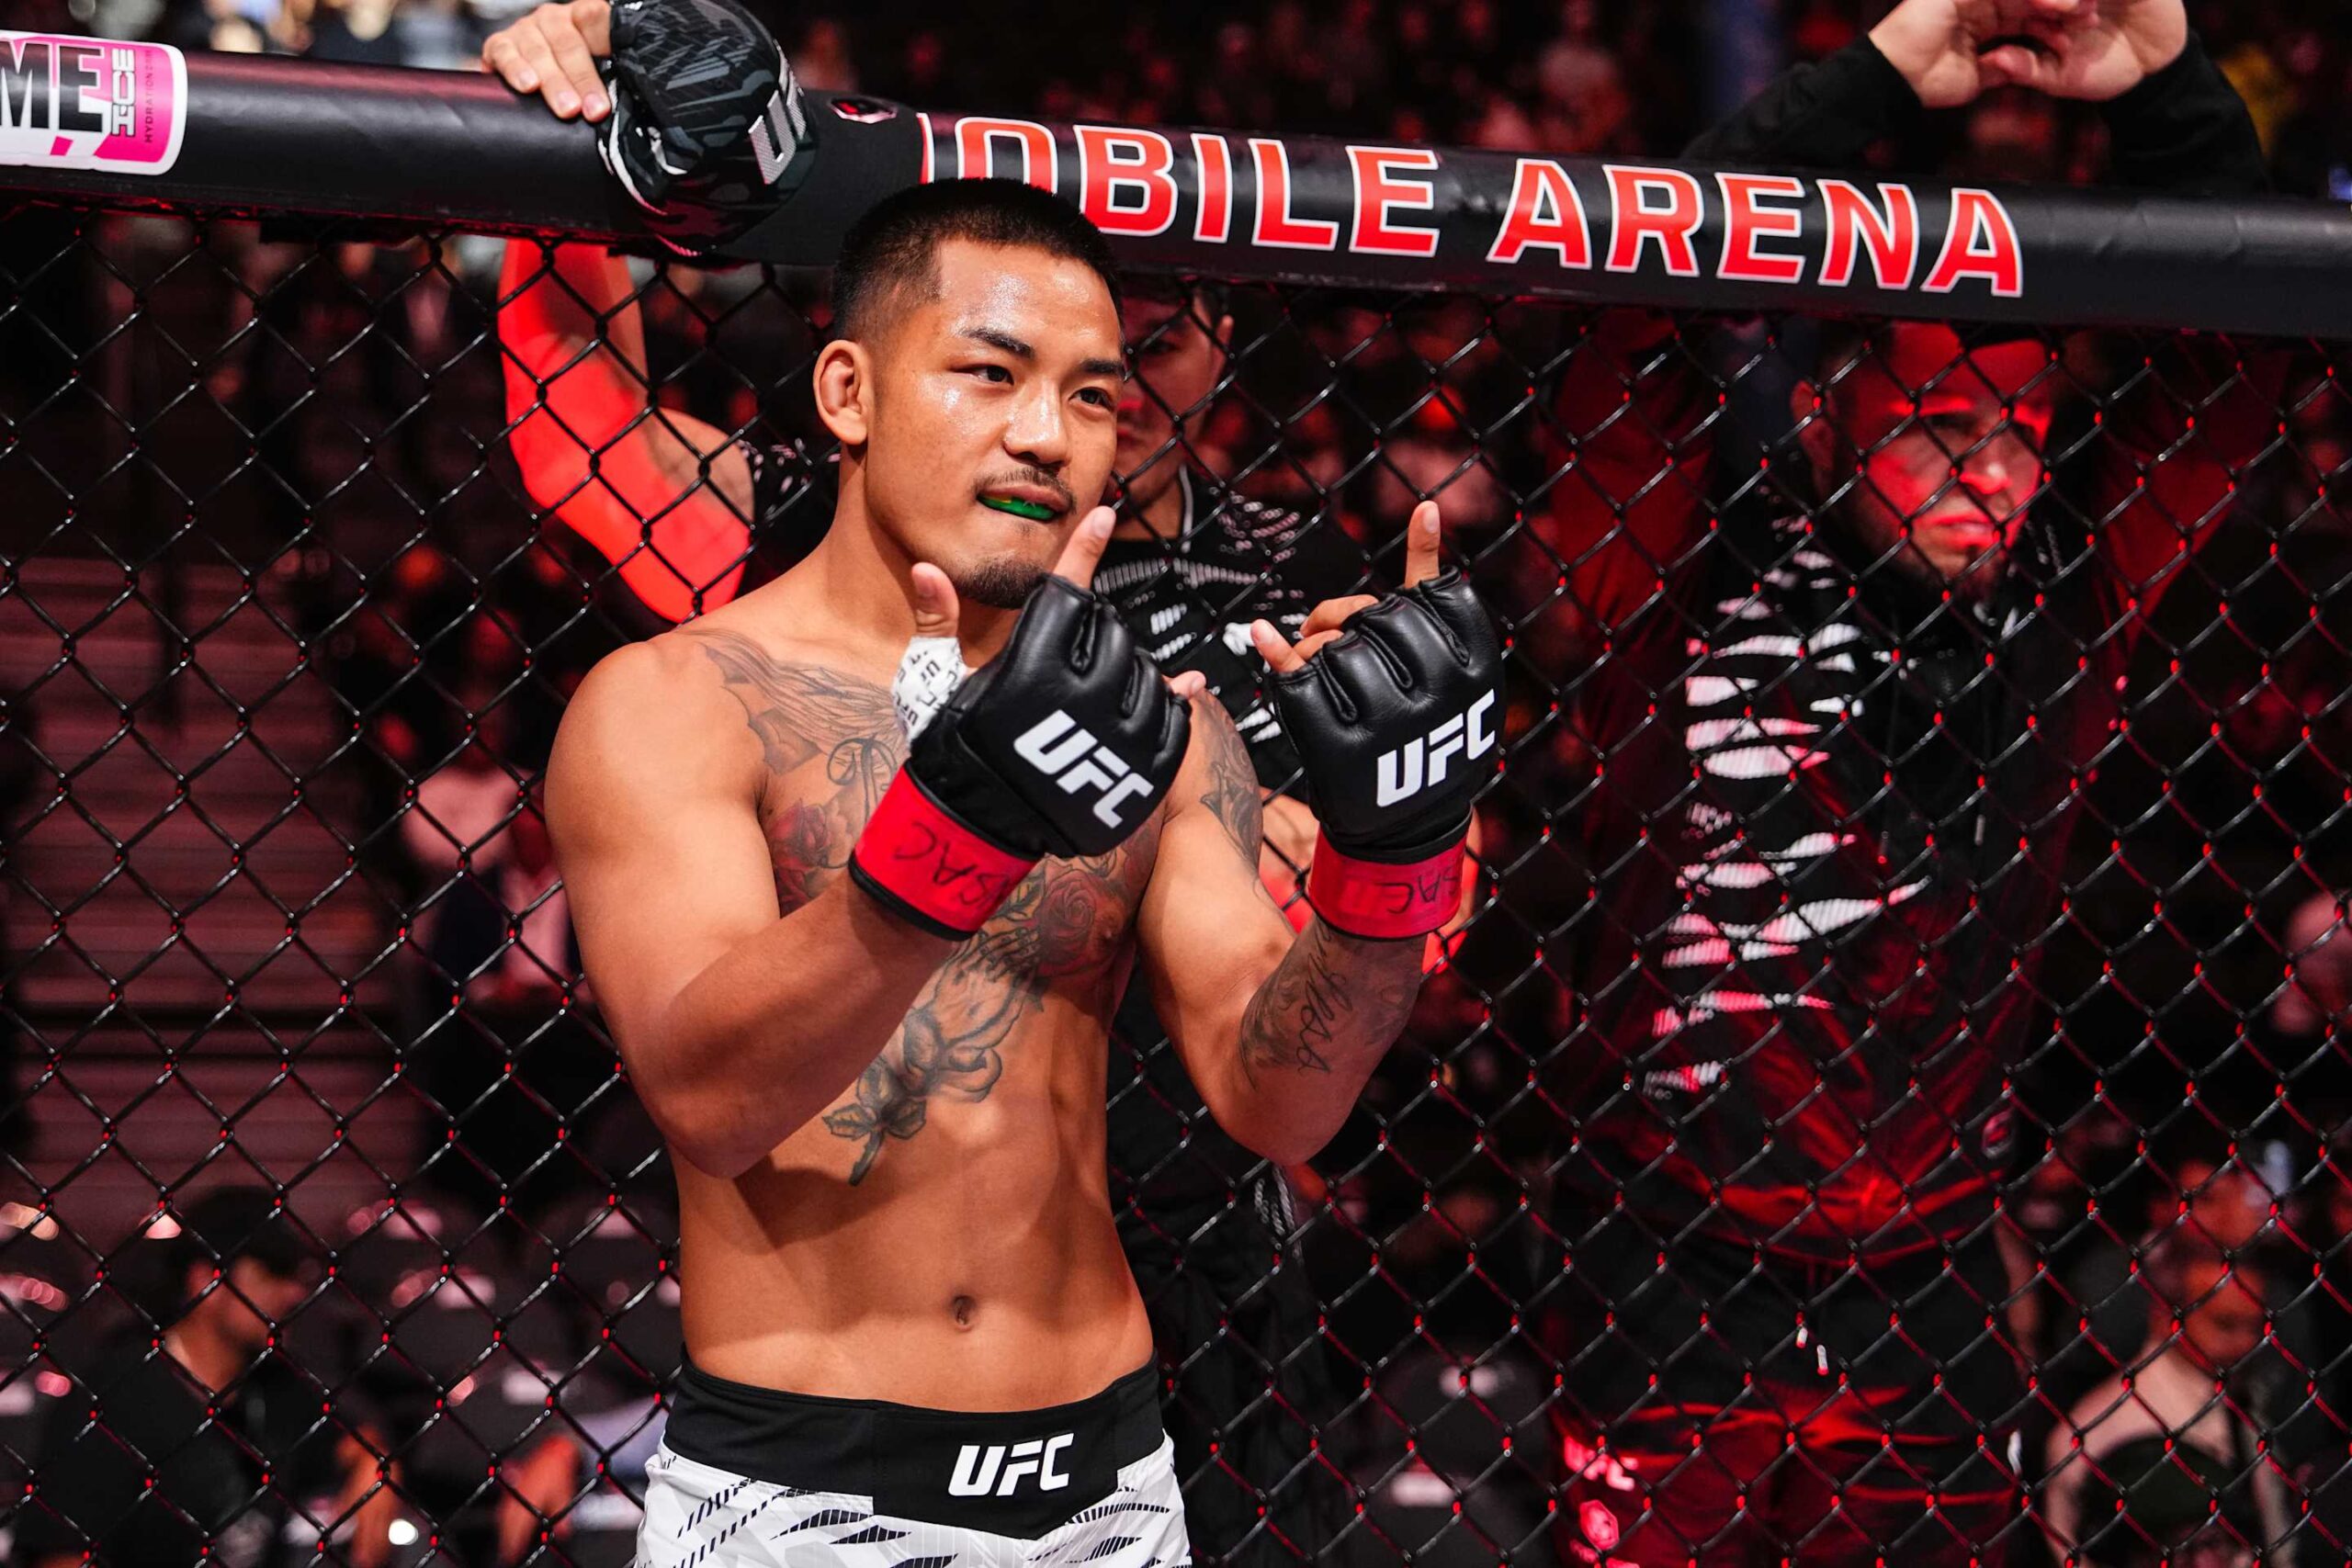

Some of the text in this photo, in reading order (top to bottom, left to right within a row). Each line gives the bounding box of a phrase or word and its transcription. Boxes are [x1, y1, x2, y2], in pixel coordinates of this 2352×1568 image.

[111, 48, 136, 137] ICE
[917, 112, 2023, 298] OBILE ARENA
[1013, 709, 1154, 829] UFC
[1376, 688, 1496, 807] UFC
[947, 1432, 1075, 1497] UFC
